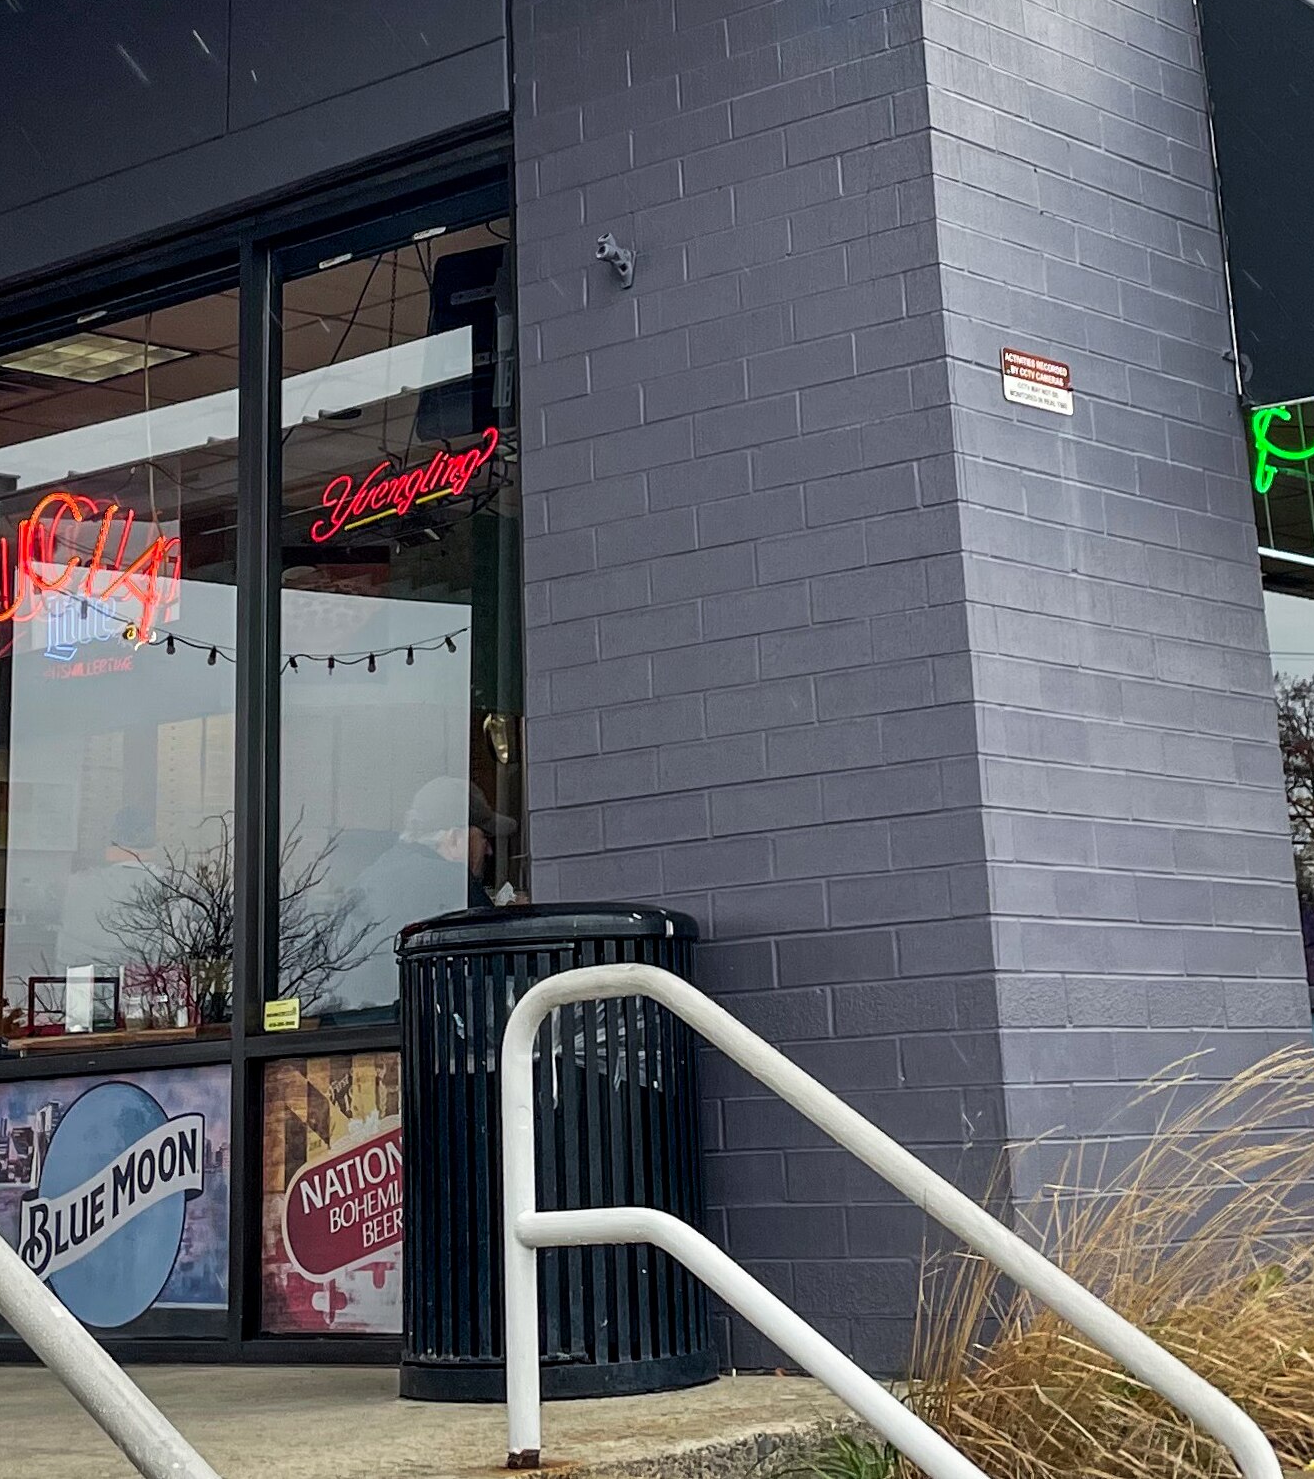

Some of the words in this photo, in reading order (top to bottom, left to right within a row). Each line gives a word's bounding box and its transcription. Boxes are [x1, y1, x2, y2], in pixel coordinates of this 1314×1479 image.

[310, 427, 499, 543] Yuengling
[22, 1182, 106, 1277] BLUE
[112, 1127, 198, 1220] MOON
[299, 1136, 403, 1215] NATION
[329, 1179, 403, 1234] BOHEMI
